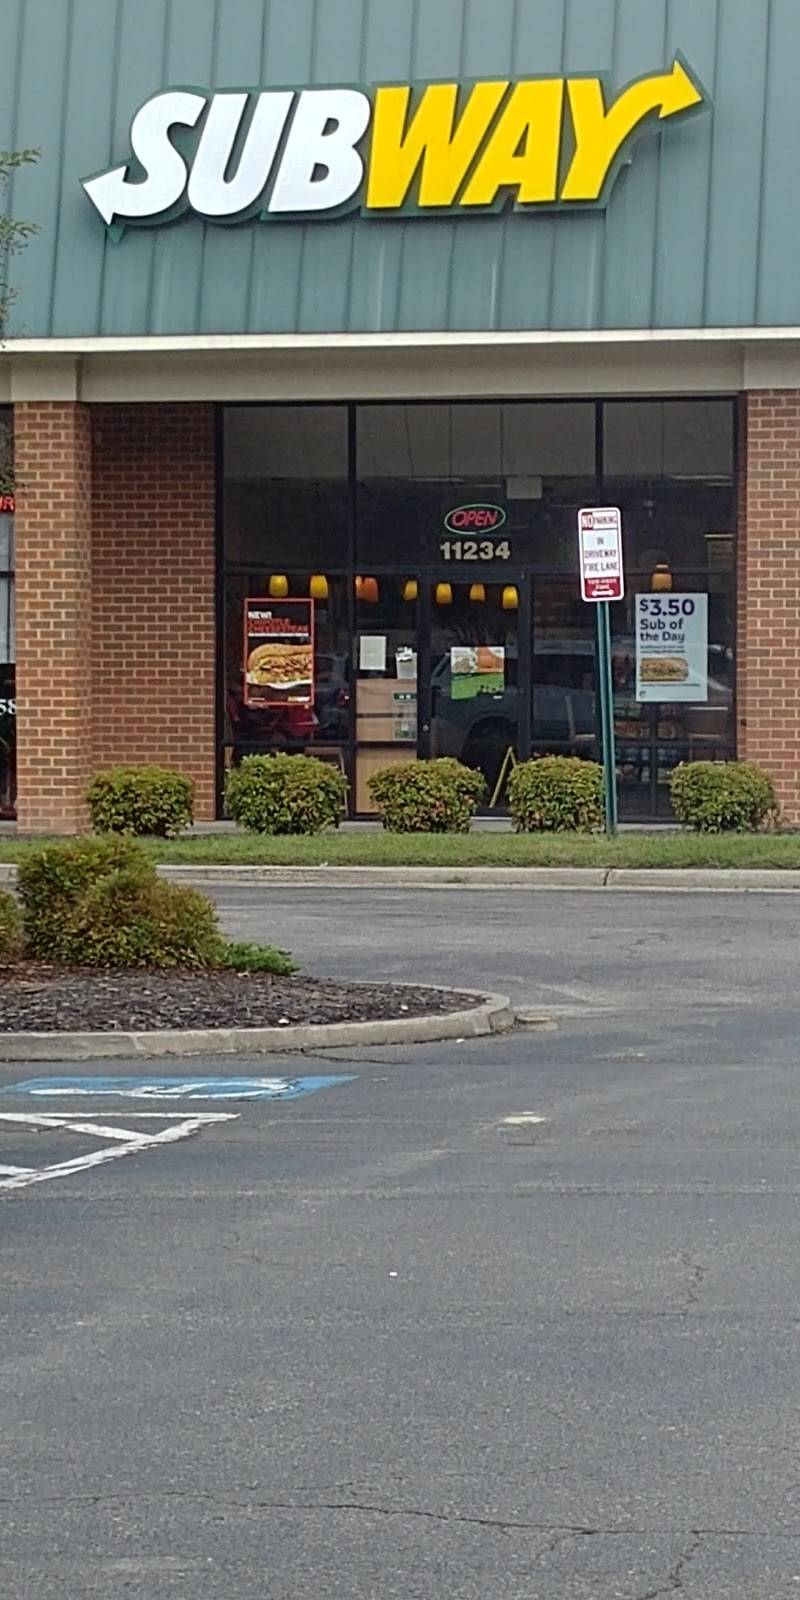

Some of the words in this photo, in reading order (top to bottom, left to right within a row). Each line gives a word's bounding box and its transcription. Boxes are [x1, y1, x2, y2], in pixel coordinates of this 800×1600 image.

[83, 60, 703, 225] SUBWAY
[452, 510, 498, 526] OPEN
[582, 513, 593, 528] NO
[593, 516, 618, 524] PARKING
[597, 537, 604, 545] IN
[440, 541, 511, 560] 11234
[584, 550, 617, 559] DRIVEWAY
[584, 563, 600, 572] FIRE
[601, 562, 618, 571] LANE
[639, 598, 695, 616] $3.50
[248, 611, 272, 619] NEW!
[640, 619, 666, 630] Sub
[669, 618, 684, 630] of
[640, 632, 659, 641] the
[662, 632, 685, 643] Day
